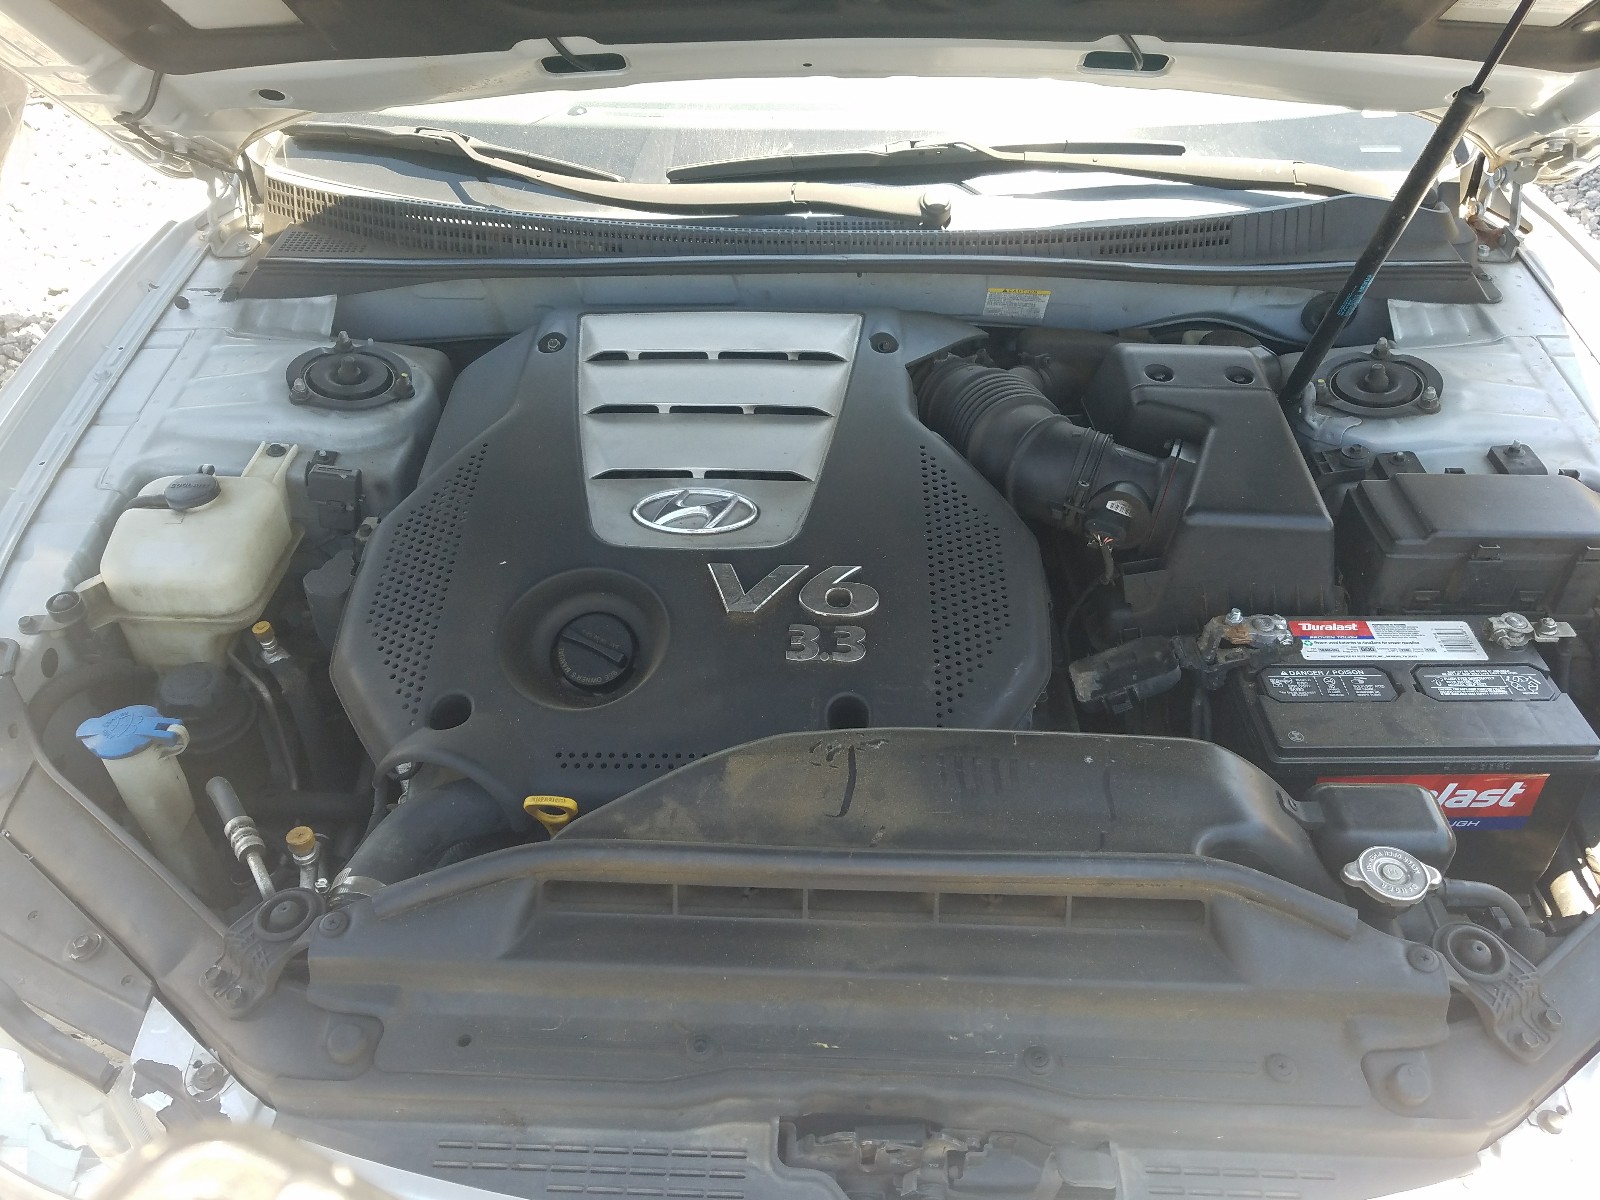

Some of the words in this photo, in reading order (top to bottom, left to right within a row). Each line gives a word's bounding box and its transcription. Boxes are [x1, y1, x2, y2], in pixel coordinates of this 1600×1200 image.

[707, 563, 880, 616] V6
[785, 624, 867, 662] 3.3
[1298, 623, 1358, 631] Duralast
[1430, 782, 1526, 808] last
